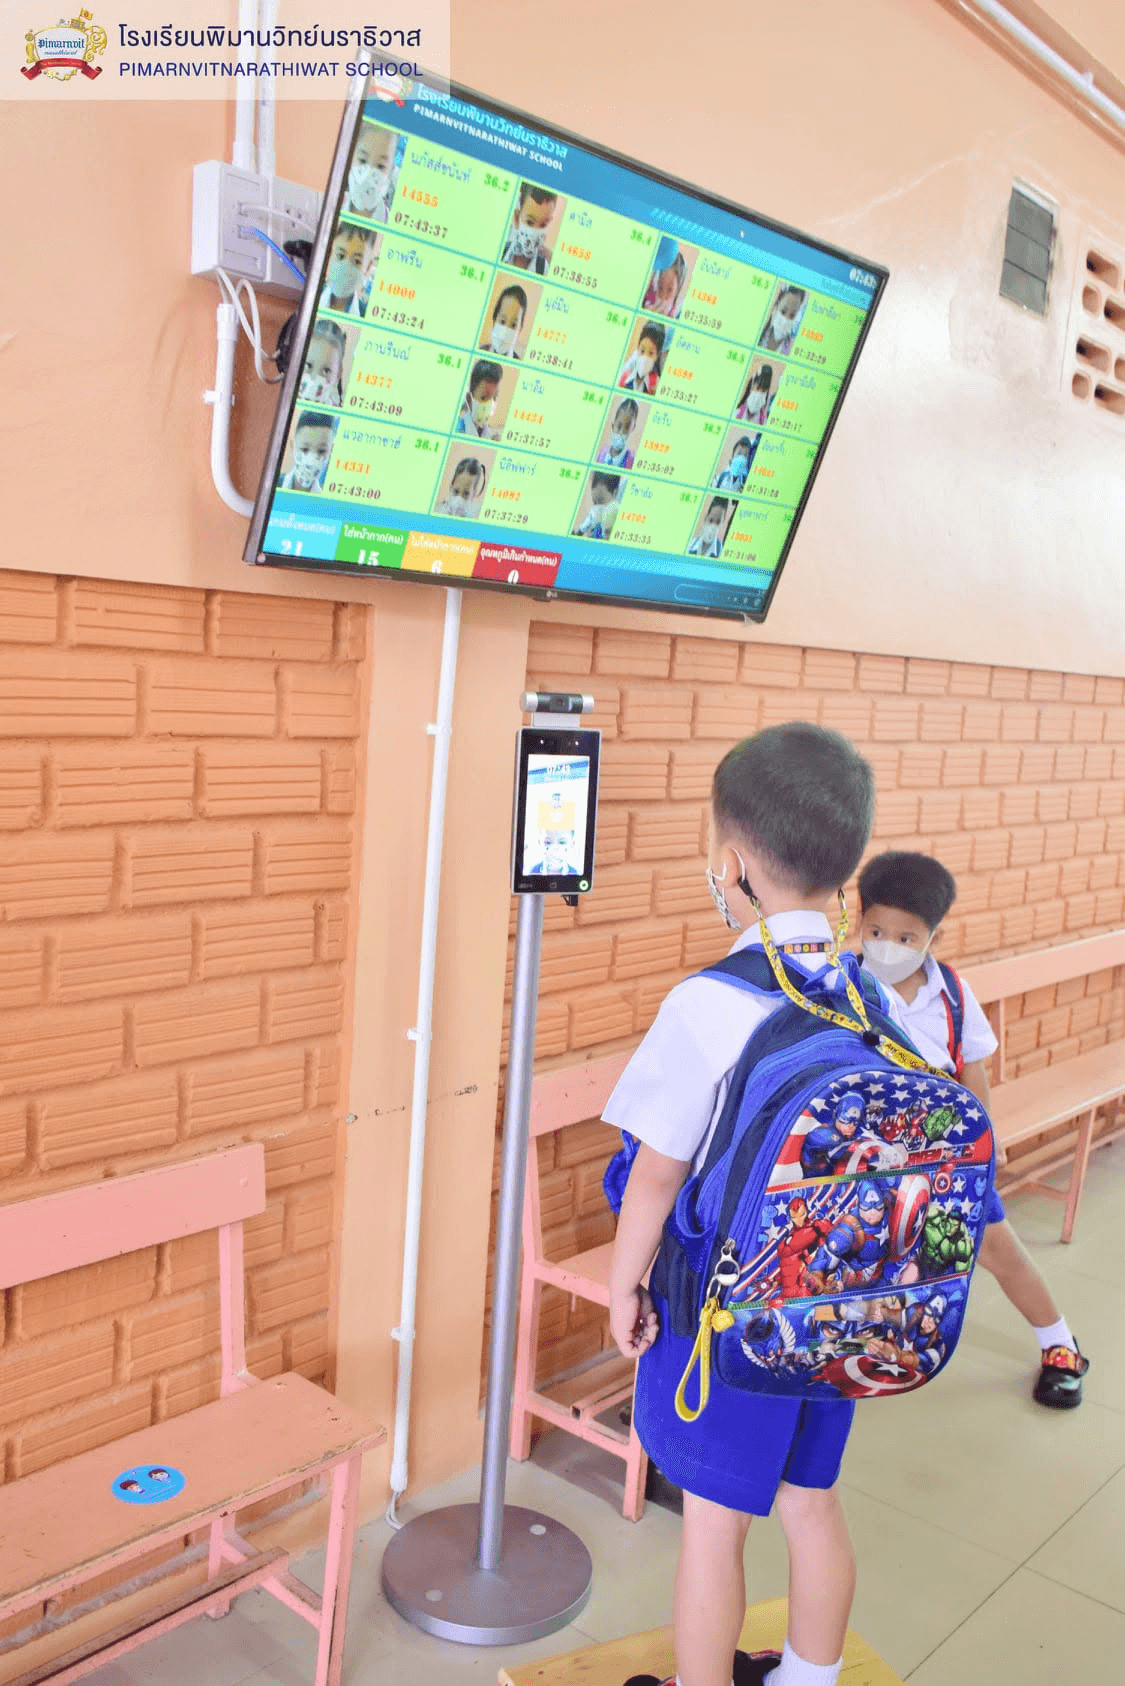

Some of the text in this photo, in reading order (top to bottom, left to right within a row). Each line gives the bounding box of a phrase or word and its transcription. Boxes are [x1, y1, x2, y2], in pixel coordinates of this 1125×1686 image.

[528, 150, 564, 172] SCHOOL
[484, 172, 510, 192] 36.2
[394, 212, 448, 238] 07:43:37
[460, 264, 485, 282] 36.1
[371, 306, 425, 330] 07:43:24
[437, 353, 462, 369] 36.1
[350, 395, 403, 416] 07:43:09
[414, 438, 440, 453] 36.1
[328, 482, 382, 500] 07:43:00
[358, 549, 380, 566] 15
